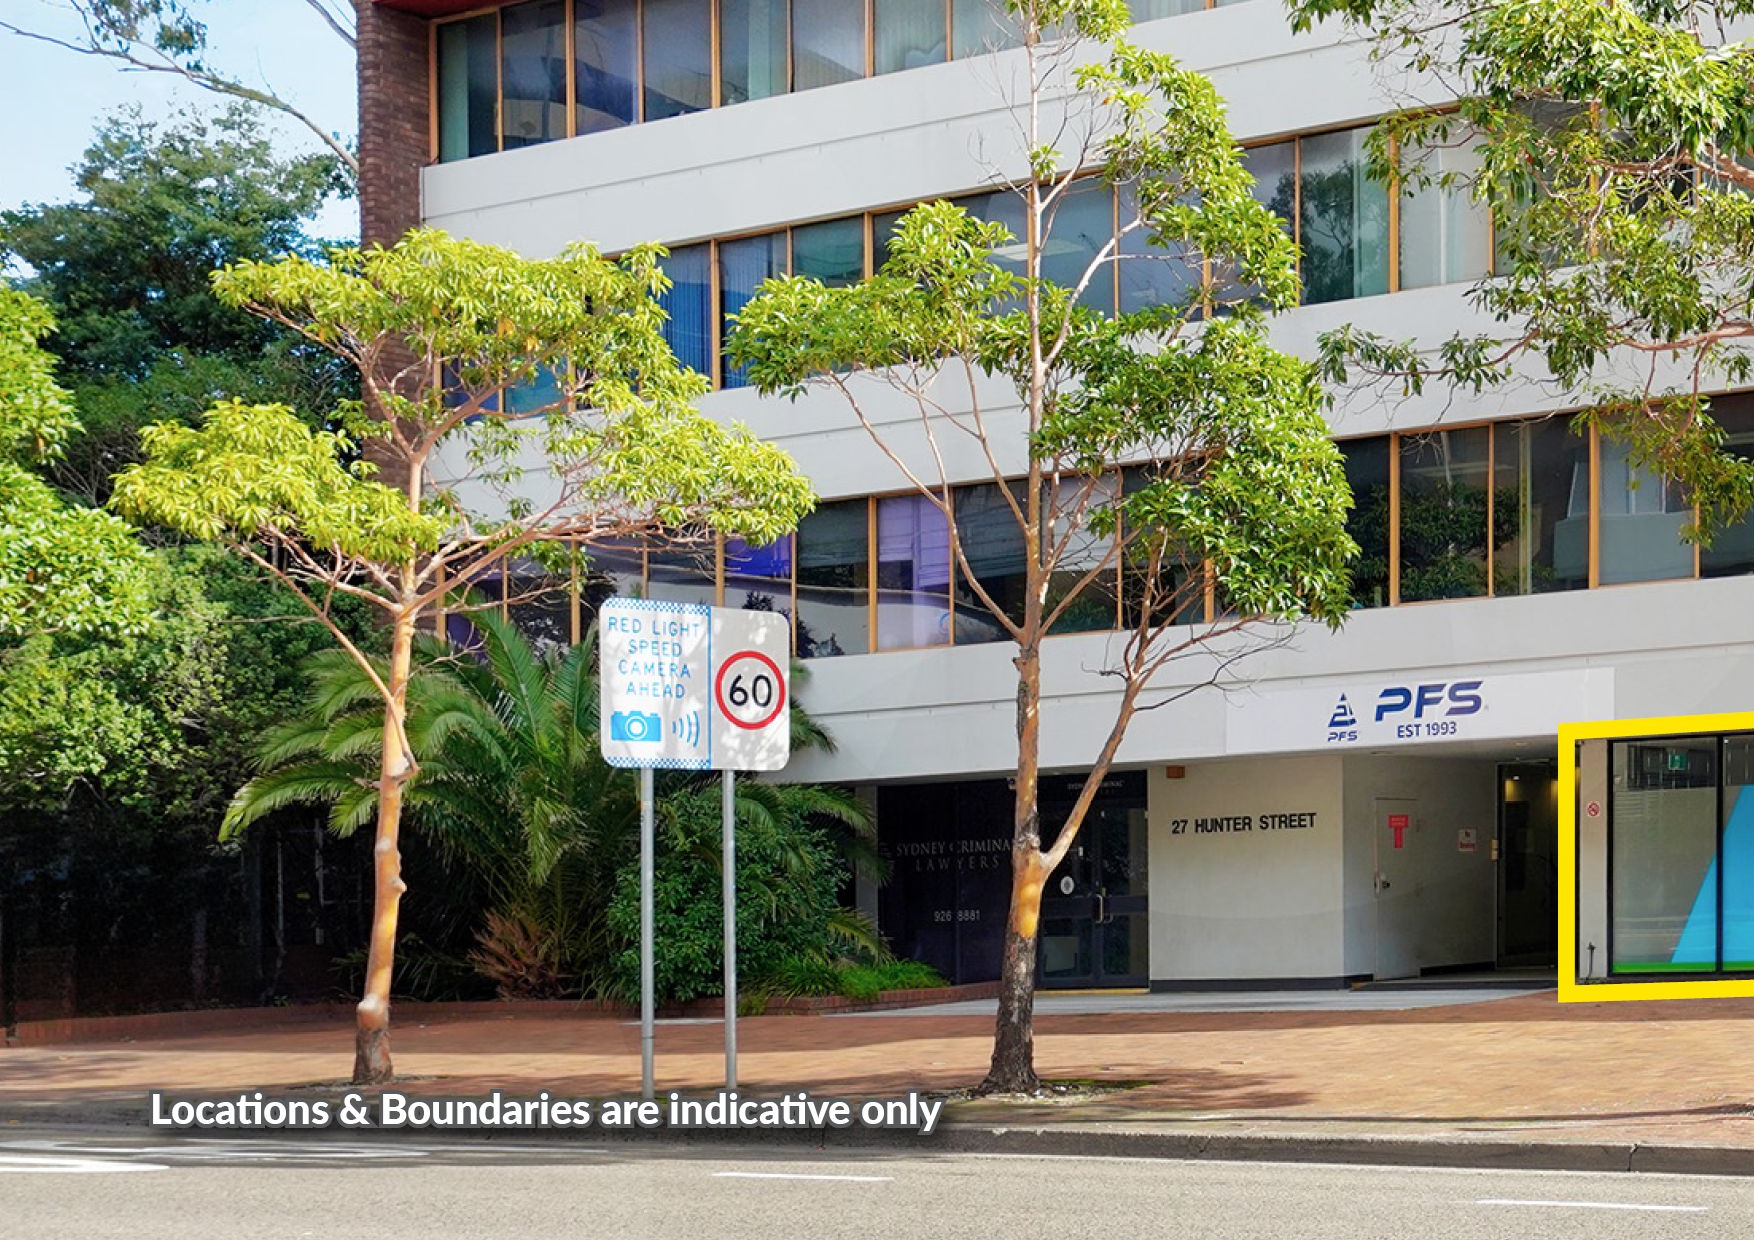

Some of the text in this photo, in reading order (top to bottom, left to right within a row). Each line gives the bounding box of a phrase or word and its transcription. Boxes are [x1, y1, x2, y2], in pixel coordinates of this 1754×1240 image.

[608, 617, 700, 637] RED LIGHT
[628, 639, 683, 658] SPEED
[618, 659, 691, 678] CAMERA
[626, 681, 686, 699] AHEAD
[729, 674, 772, 707] 60
[1375, 680, 1483, 722] PFS
[1327, 731, 1358, 742] PFS
[1397, 721, 1457, 738] EST 1993
[1172, 813, 1316, 834] 27 HUNTER STREET
[896, 839, 1011, 857] SYDNEY CRIMINA
[915, 855, 1000, 872] LAWYERS
